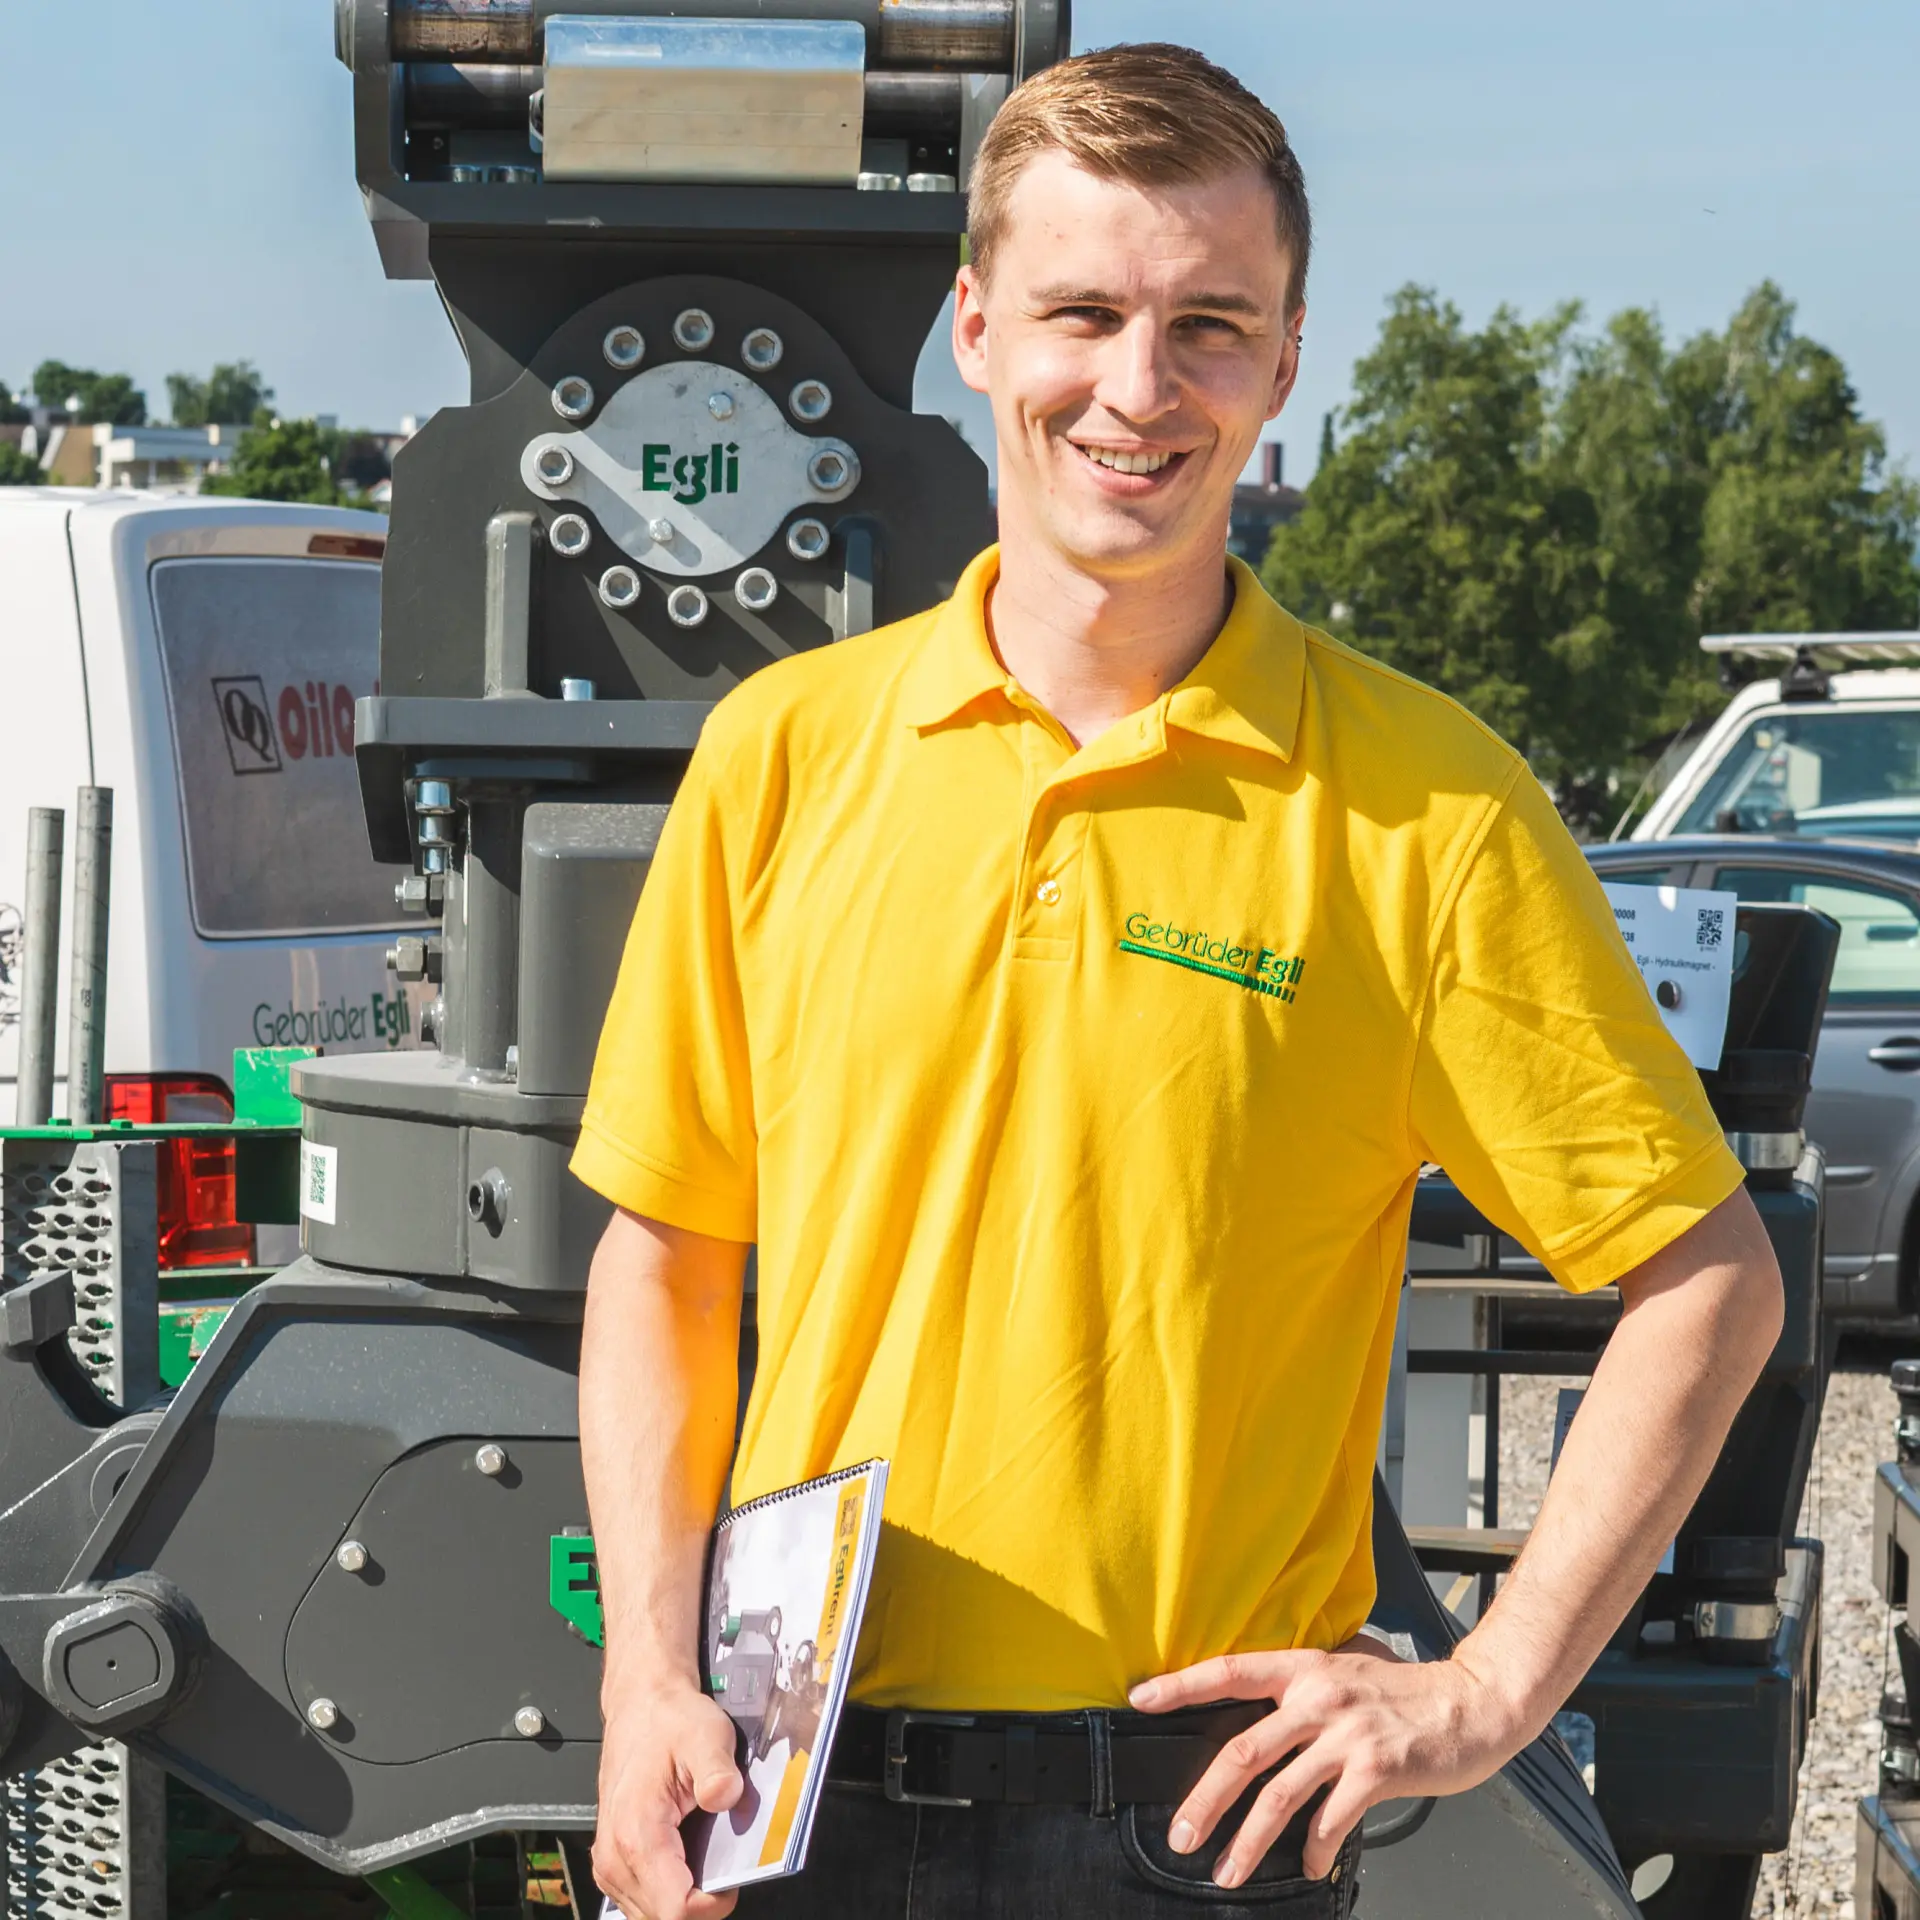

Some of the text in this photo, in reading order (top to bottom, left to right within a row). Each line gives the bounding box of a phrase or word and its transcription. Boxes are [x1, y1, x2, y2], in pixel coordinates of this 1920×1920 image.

[642, 442, 740, 505] Egli
[1125, 912, 1306, 985] Gebrüder Egli
[253, 989, 411, 1047] Gebrüder Egli
